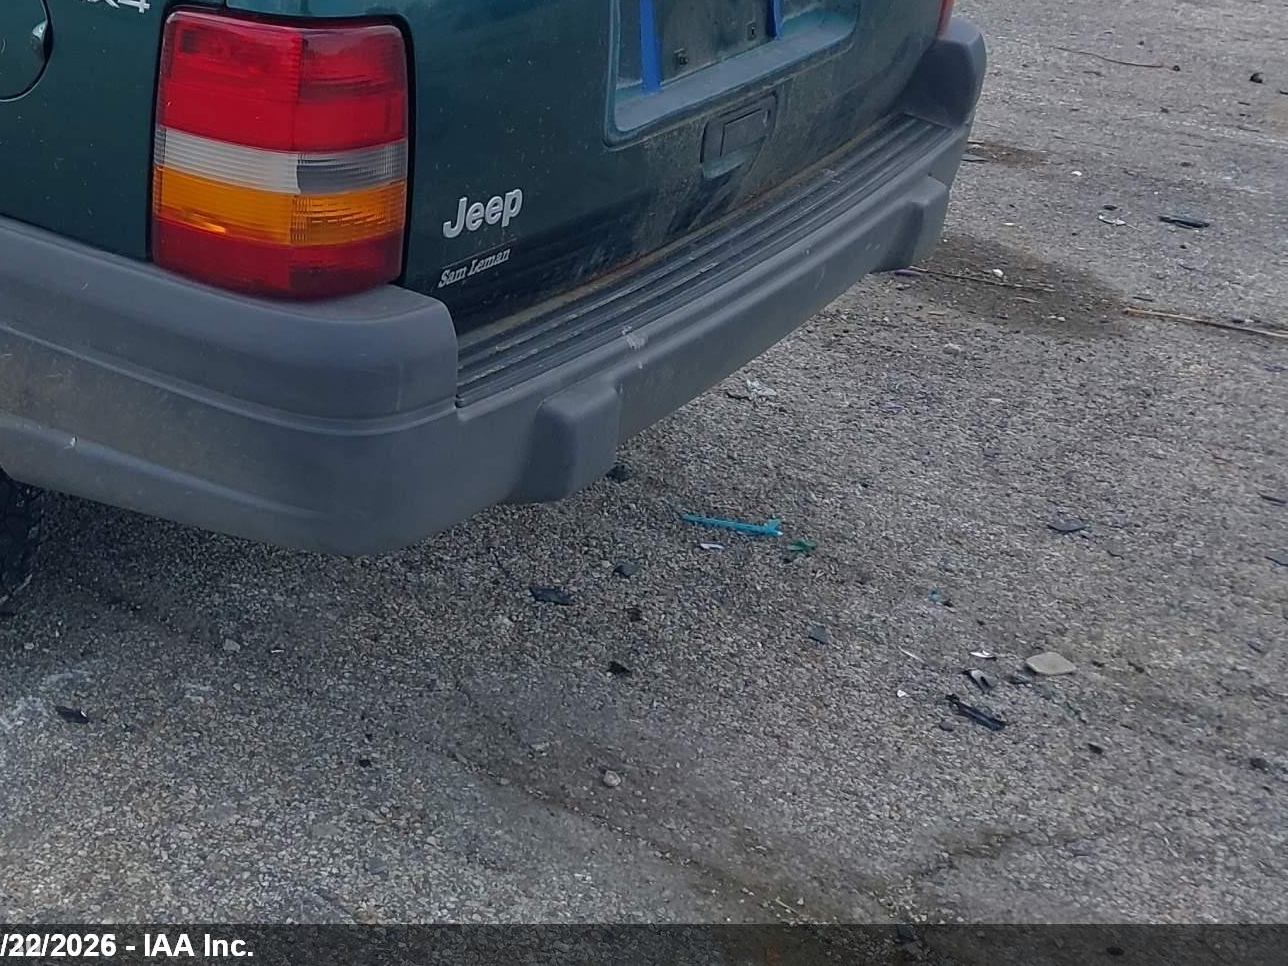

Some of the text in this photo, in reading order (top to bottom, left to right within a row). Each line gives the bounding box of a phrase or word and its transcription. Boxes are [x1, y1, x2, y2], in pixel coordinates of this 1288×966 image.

[442, 188, 523, 238] Jeep
[437, 248, 511, 288] Sam Leman
